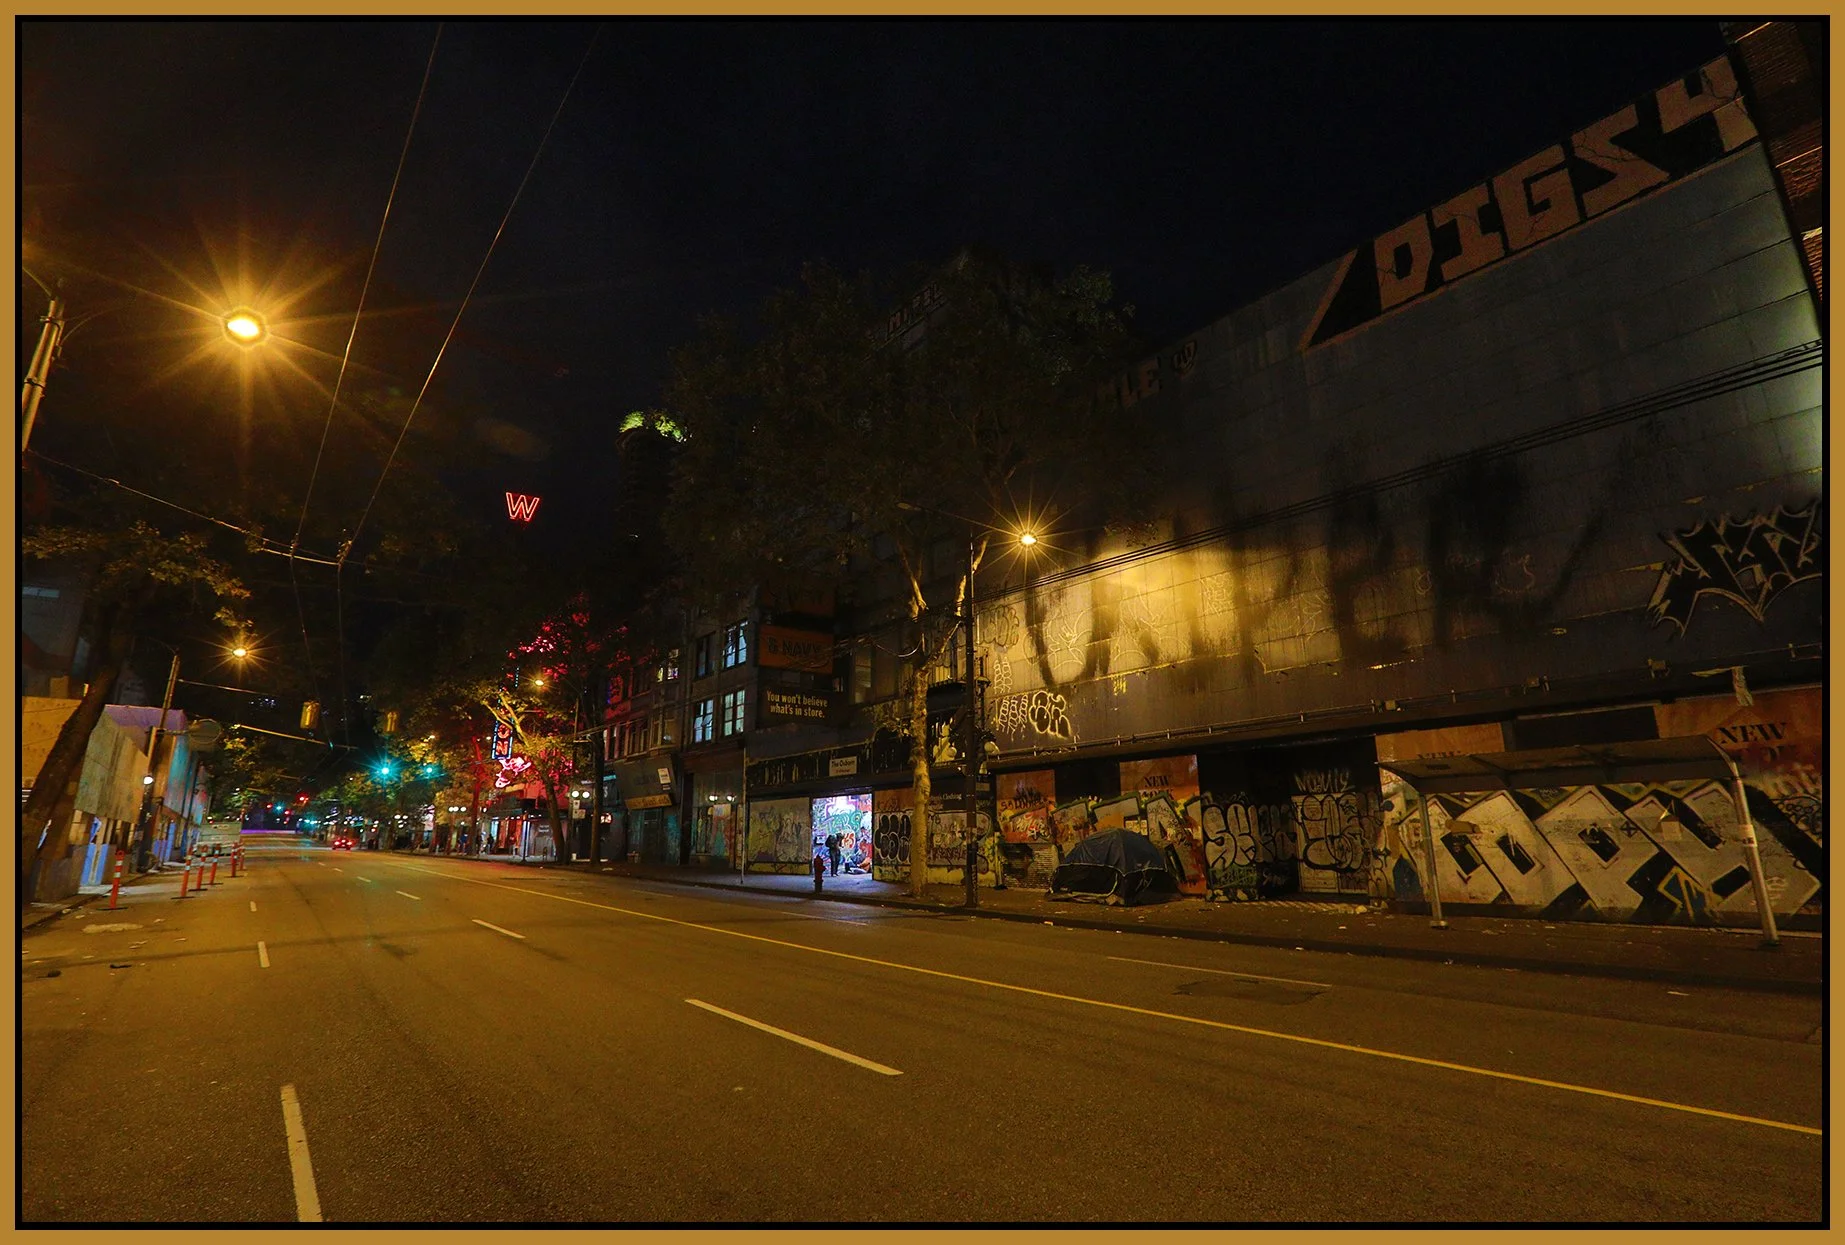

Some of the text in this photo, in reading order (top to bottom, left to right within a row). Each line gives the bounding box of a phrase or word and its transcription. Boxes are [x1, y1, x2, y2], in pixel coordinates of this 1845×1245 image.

[506, 491, 540, 522] W
[767, 691, 828, 707] You won't believe
[770, 703, 825, 718] what's in store.
[1717, 722, 1789, 744] NEW
[1143, 775, 1173, 788] NEW
